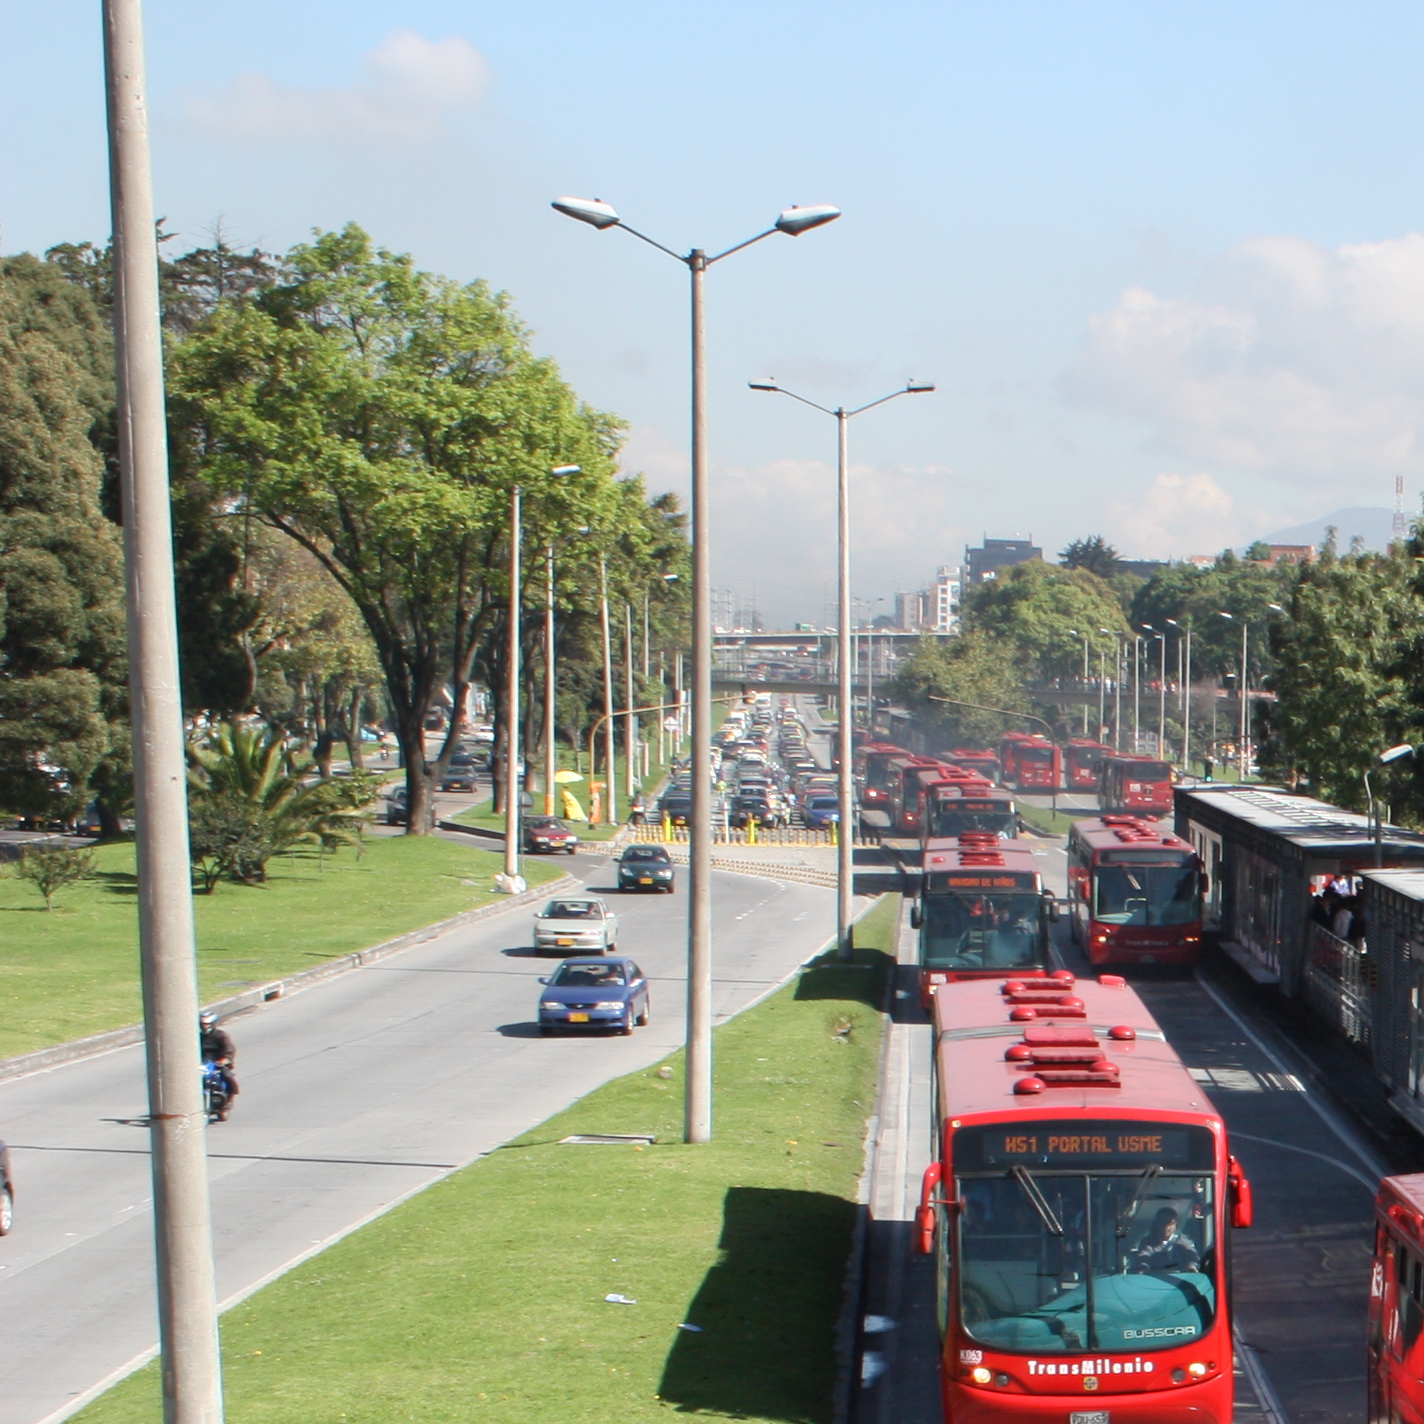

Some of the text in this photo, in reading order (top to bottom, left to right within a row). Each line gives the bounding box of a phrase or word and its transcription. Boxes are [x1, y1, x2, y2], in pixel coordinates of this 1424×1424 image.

[1048, 1135, 1112, 1153] PORTAL
[1117, 1134, 1162, 1152] USME
[1123, 1326, 1196, 1339] BUSSCAR
[1027, 1356, 1154, 1375] TransMilenio
